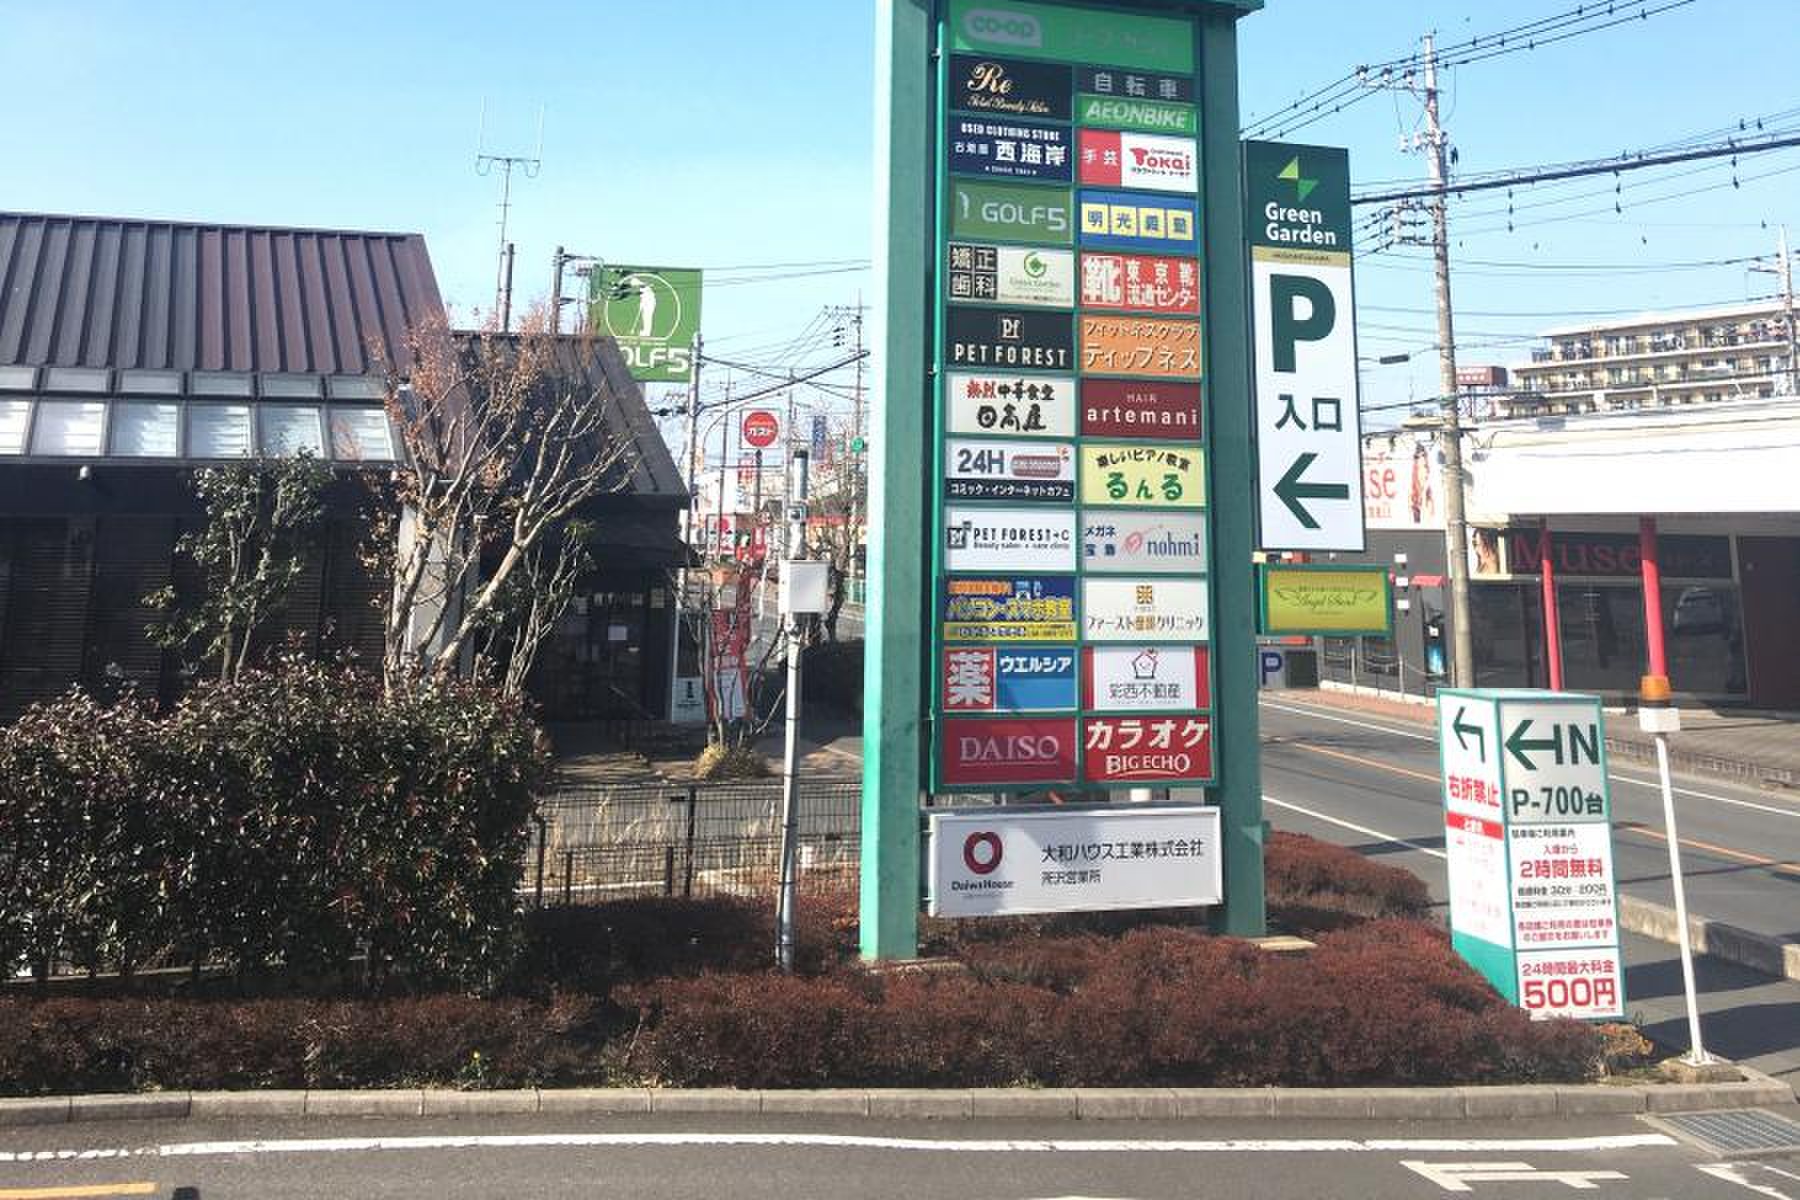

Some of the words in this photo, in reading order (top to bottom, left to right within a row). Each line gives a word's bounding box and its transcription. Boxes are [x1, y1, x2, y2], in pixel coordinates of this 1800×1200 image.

[1094, 72, 1178, 99] 自転車
[995, 140, 1066, 166] 西海岸
[981, 202, 1066, 231] GOLF5
[1265, 202, 1322, 224] Green
[1265, 223, 1336, 245] Garden
[952, 275, 995, 297] 歯科
[1270, 273, 1335, 373] P
[955, 343, 987, 362] PET
[995, 347, 1066, 366] FOREST
[1085, 343, 1197, 371] ティップネス
[977, 403, 1047, 432] 日高屋
[1087, 406, 1197, 425] artemani
[1274, 394, 1342, 432] 入口
[958, 448, 1004, 474] 24H
[1106, 472, 1183, 500] るんる
[974, 528, 996, 541] PET
[1147, 531, 1199, 556] nohmi
[1000, 656, 1071, 673] ウエルシア
[947, 651, 992, 705] 薬
[960, 735, 1059, 761] DAISO
[1086, 720, 1209, 750] カラオケ
[1553, 724, 1600, 765] IN
[1106, 755, 1139, 774] BIG
[1142, 753, 1190, 772] ECHO
[1448, 773, 1500, 808] 右折禁止
[1512, 787, 1603, 815] P-700台
[1041, 839, 1204, 863] 大和ハウス工業株式会社
[1520, 858, 1603, 878] 2時間無料
[1522, 960, 1614, 976] 24時間最大料金
[1524, 978, 1616, 1009] 500円
